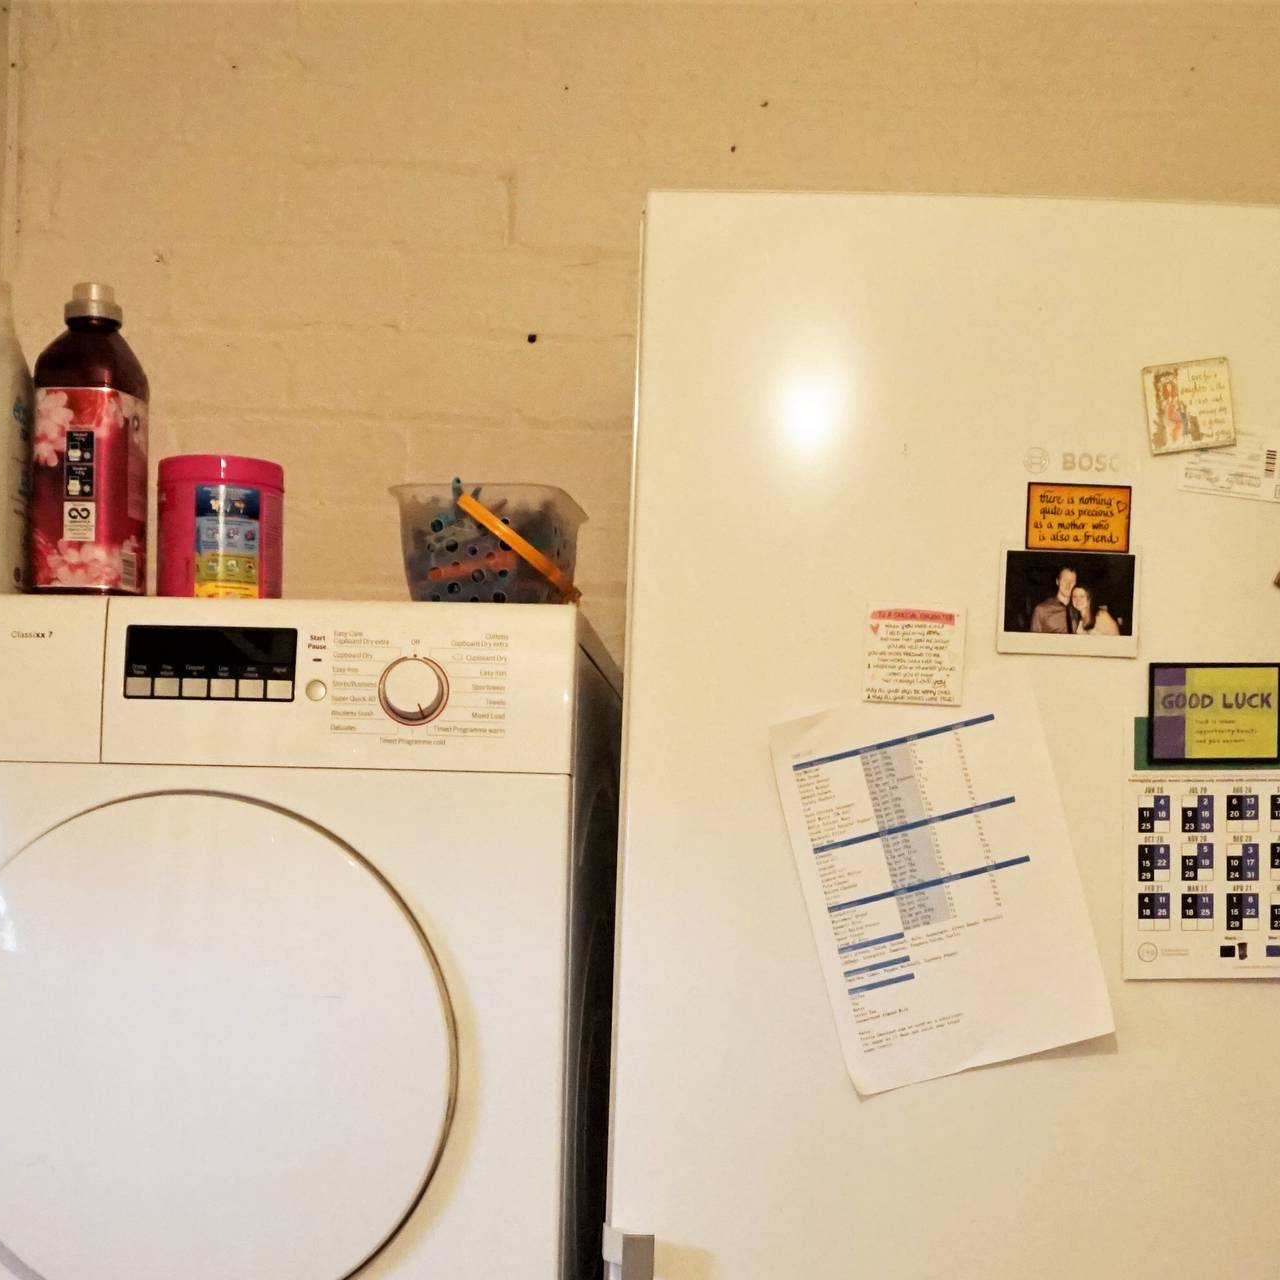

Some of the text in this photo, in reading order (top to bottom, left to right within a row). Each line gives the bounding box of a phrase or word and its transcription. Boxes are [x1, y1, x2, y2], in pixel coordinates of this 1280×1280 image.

[1067, 494, 1074, 504] is
[1079, 493, 1113, 508] nothing
[1077, 508, 1114, 520] precious
[1057, 521, 1086, 530] mother
[1092, 520, 1109, 530] who
[1050, 530, 1070, 541] also
[1080, 531, 1119, 544] friend
[10, 630, 45, 639] Classixx
[1161, 692, 1272, 710] GOOD LUCK
[453, 726, 487, 735] Programme
[398, 738, 432, 746] Programme
